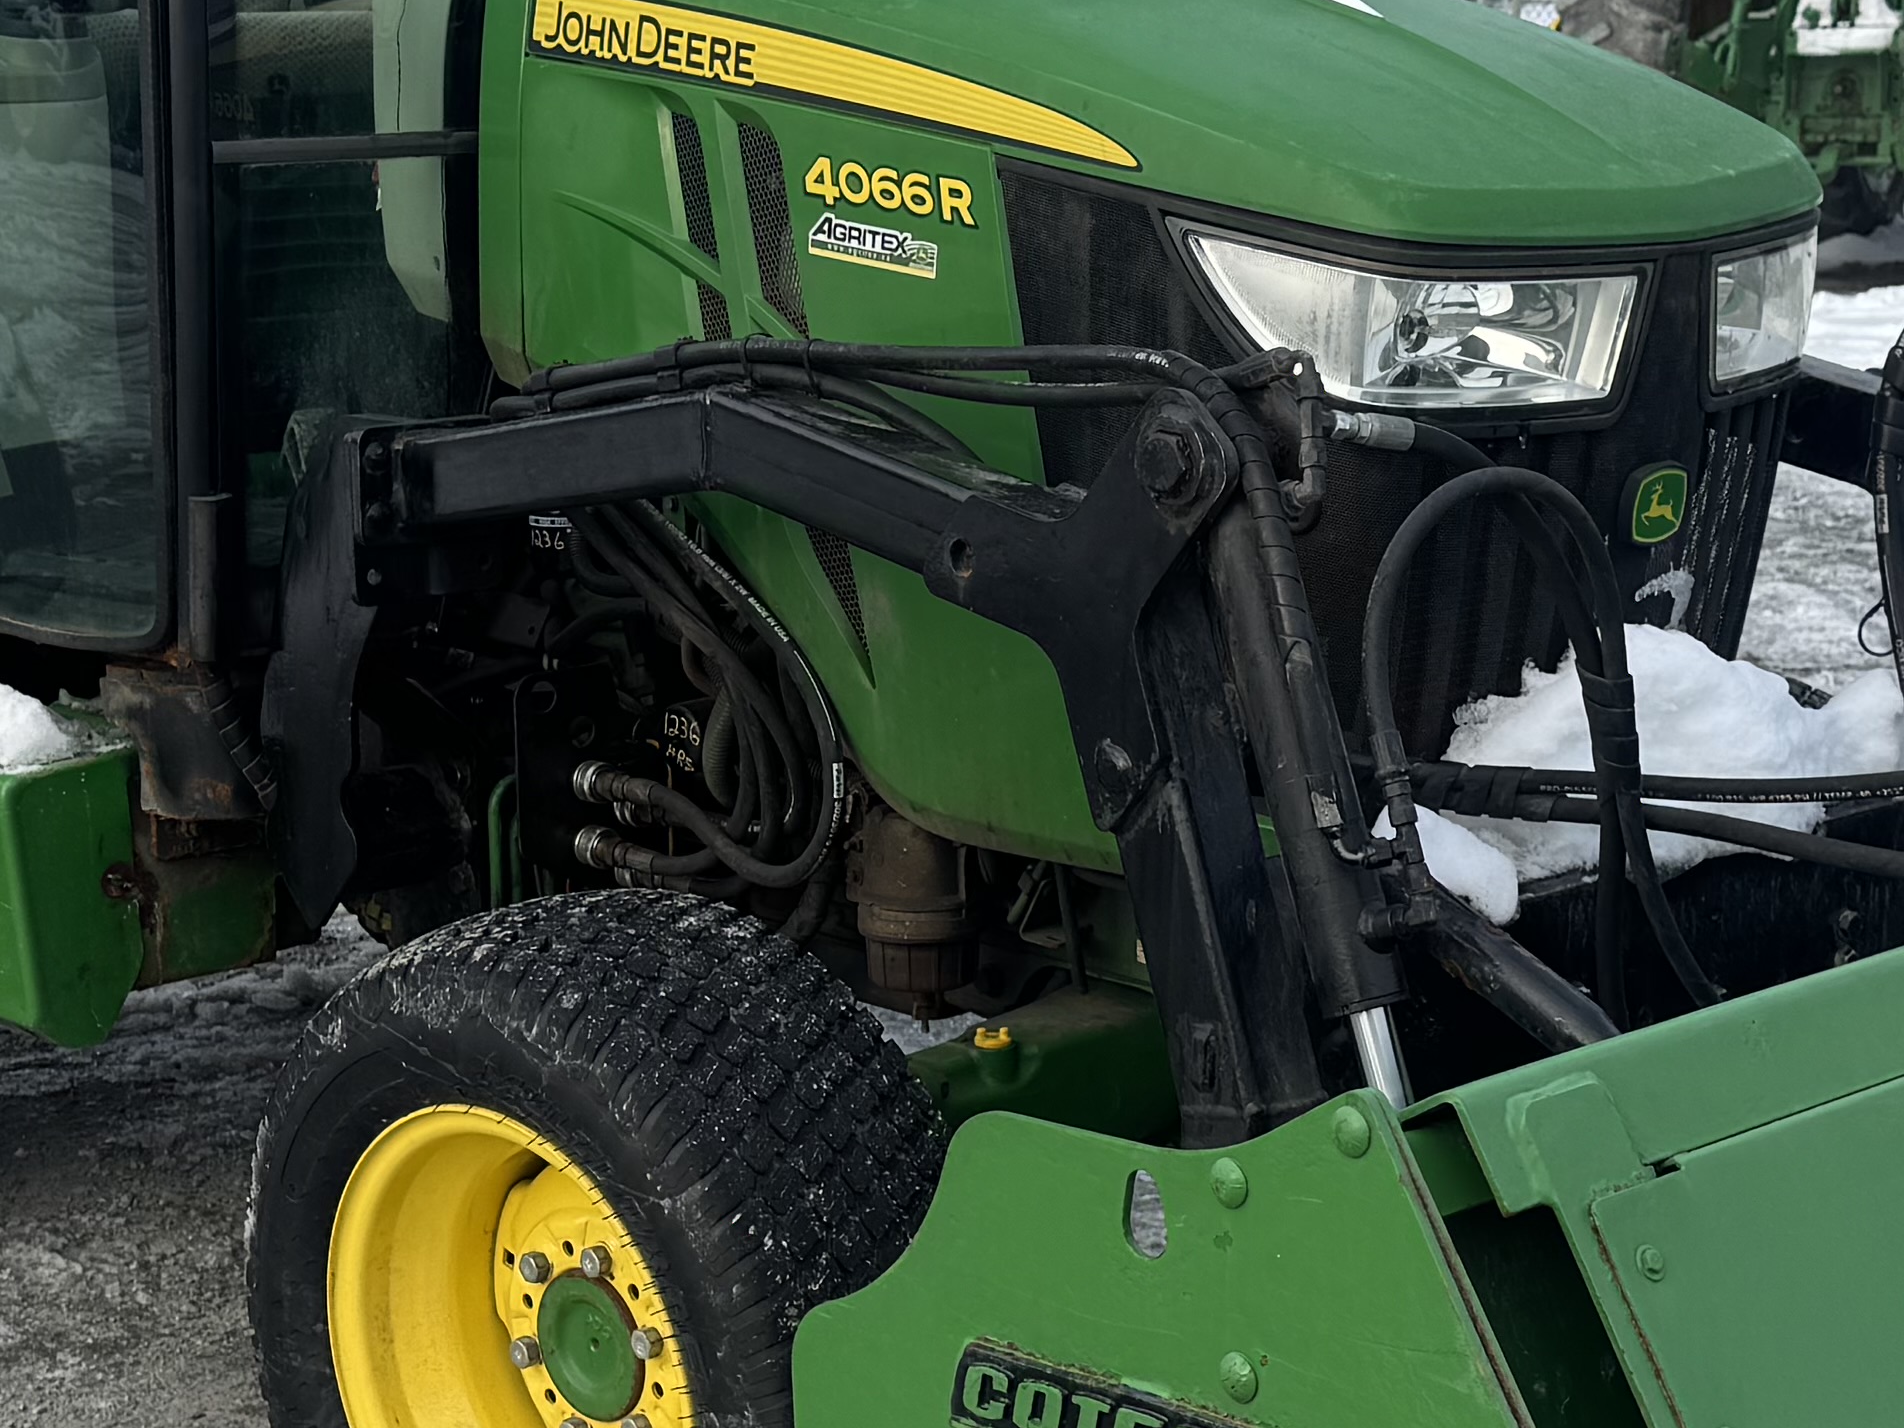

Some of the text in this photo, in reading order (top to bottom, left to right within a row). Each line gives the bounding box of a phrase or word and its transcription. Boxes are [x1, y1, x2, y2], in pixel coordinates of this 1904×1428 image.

[544, 0, 756, 80] JOHN DEERE
[811, 216, 909, 258] AGRITEX
[531, 529, 565, 550] 1236
[747, 596, 769, 619] MADE
[773, 625, 790, 643] USA
[664, 712, 701, 747] 1236
